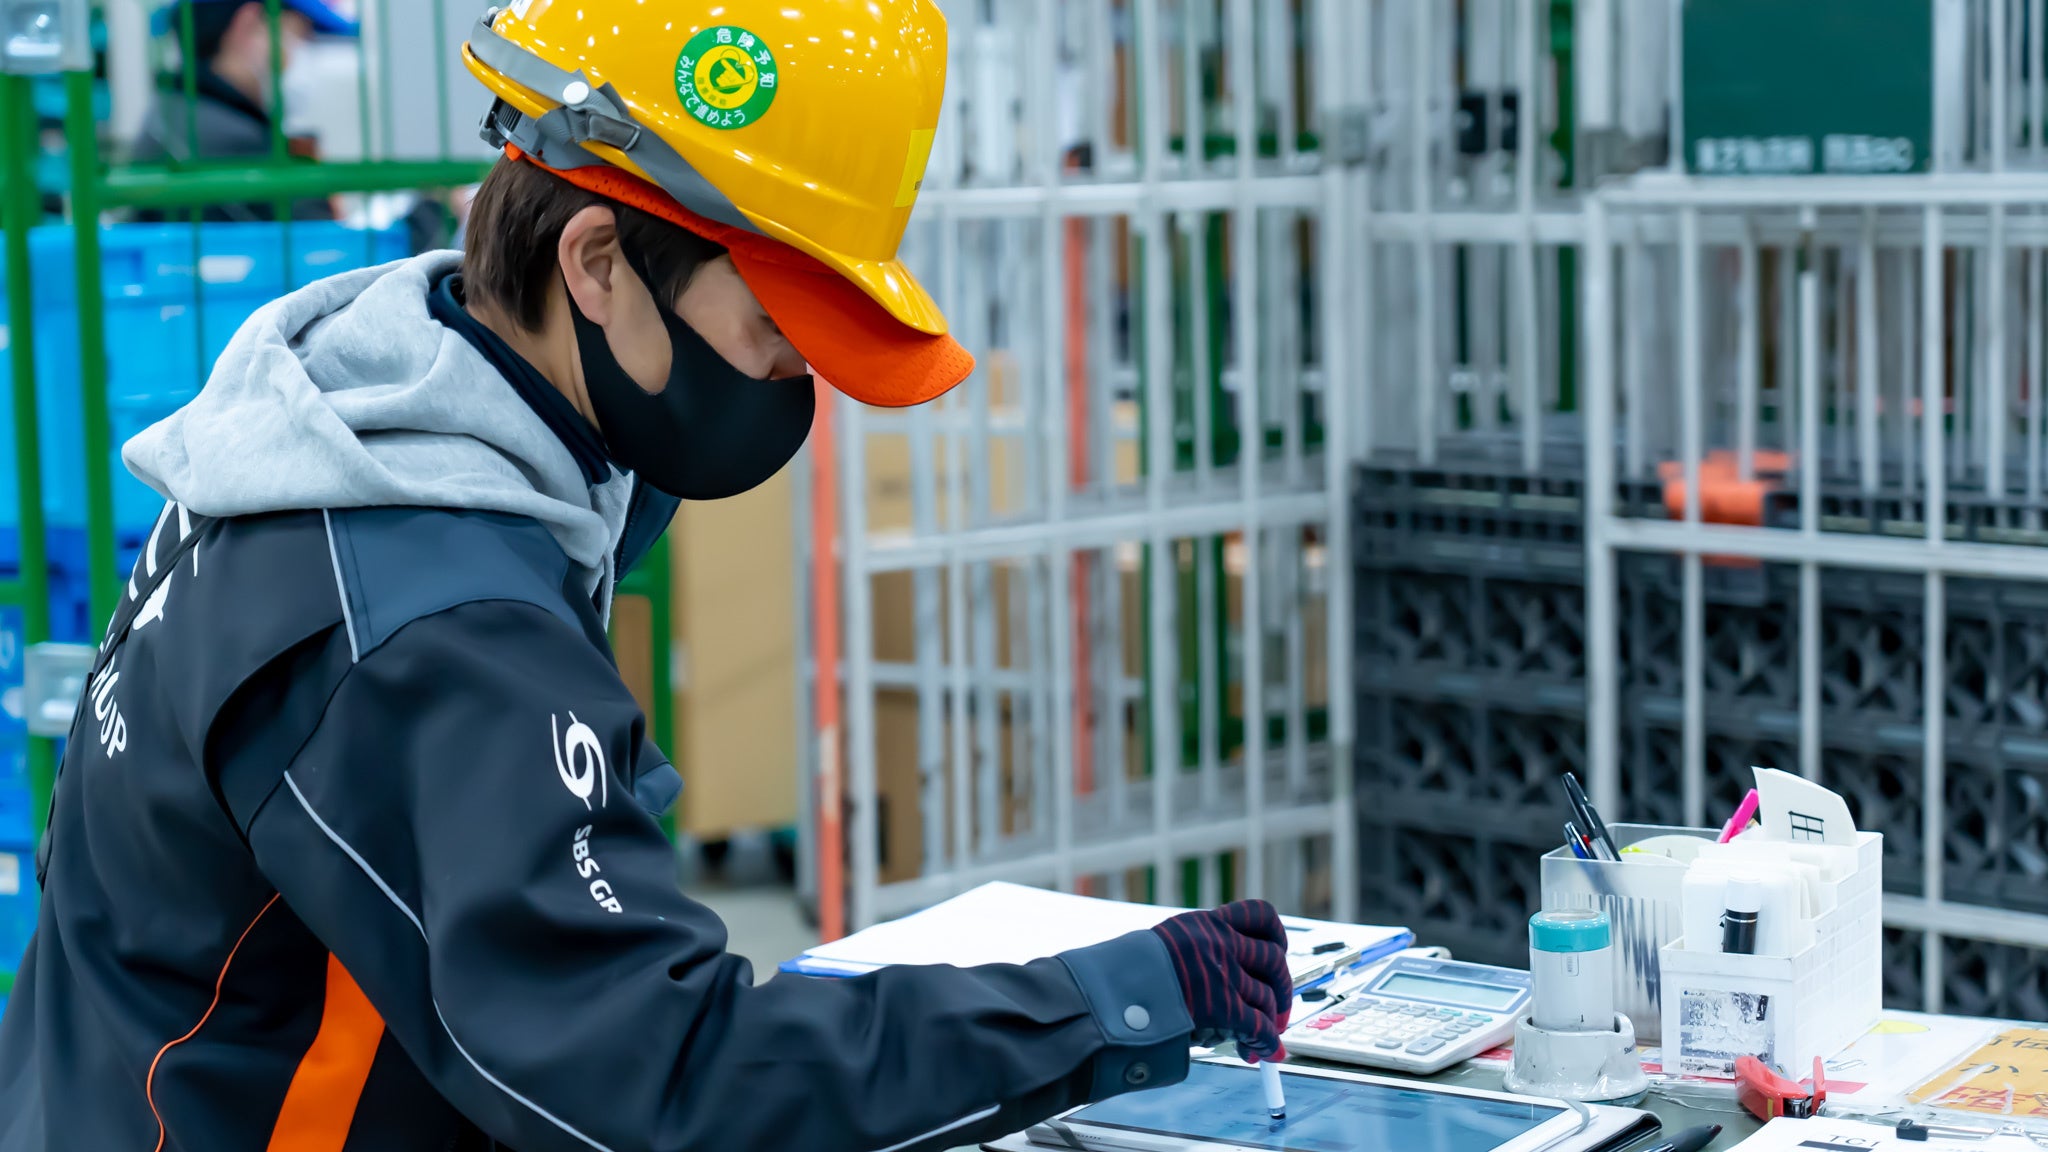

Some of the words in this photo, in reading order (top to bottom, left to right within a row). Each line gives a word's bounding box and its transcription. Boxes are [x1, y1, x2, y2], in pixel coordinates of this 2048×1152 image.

[716, 28, 776, 88] 危険予知
[572, 824, 601, 879] SBS
